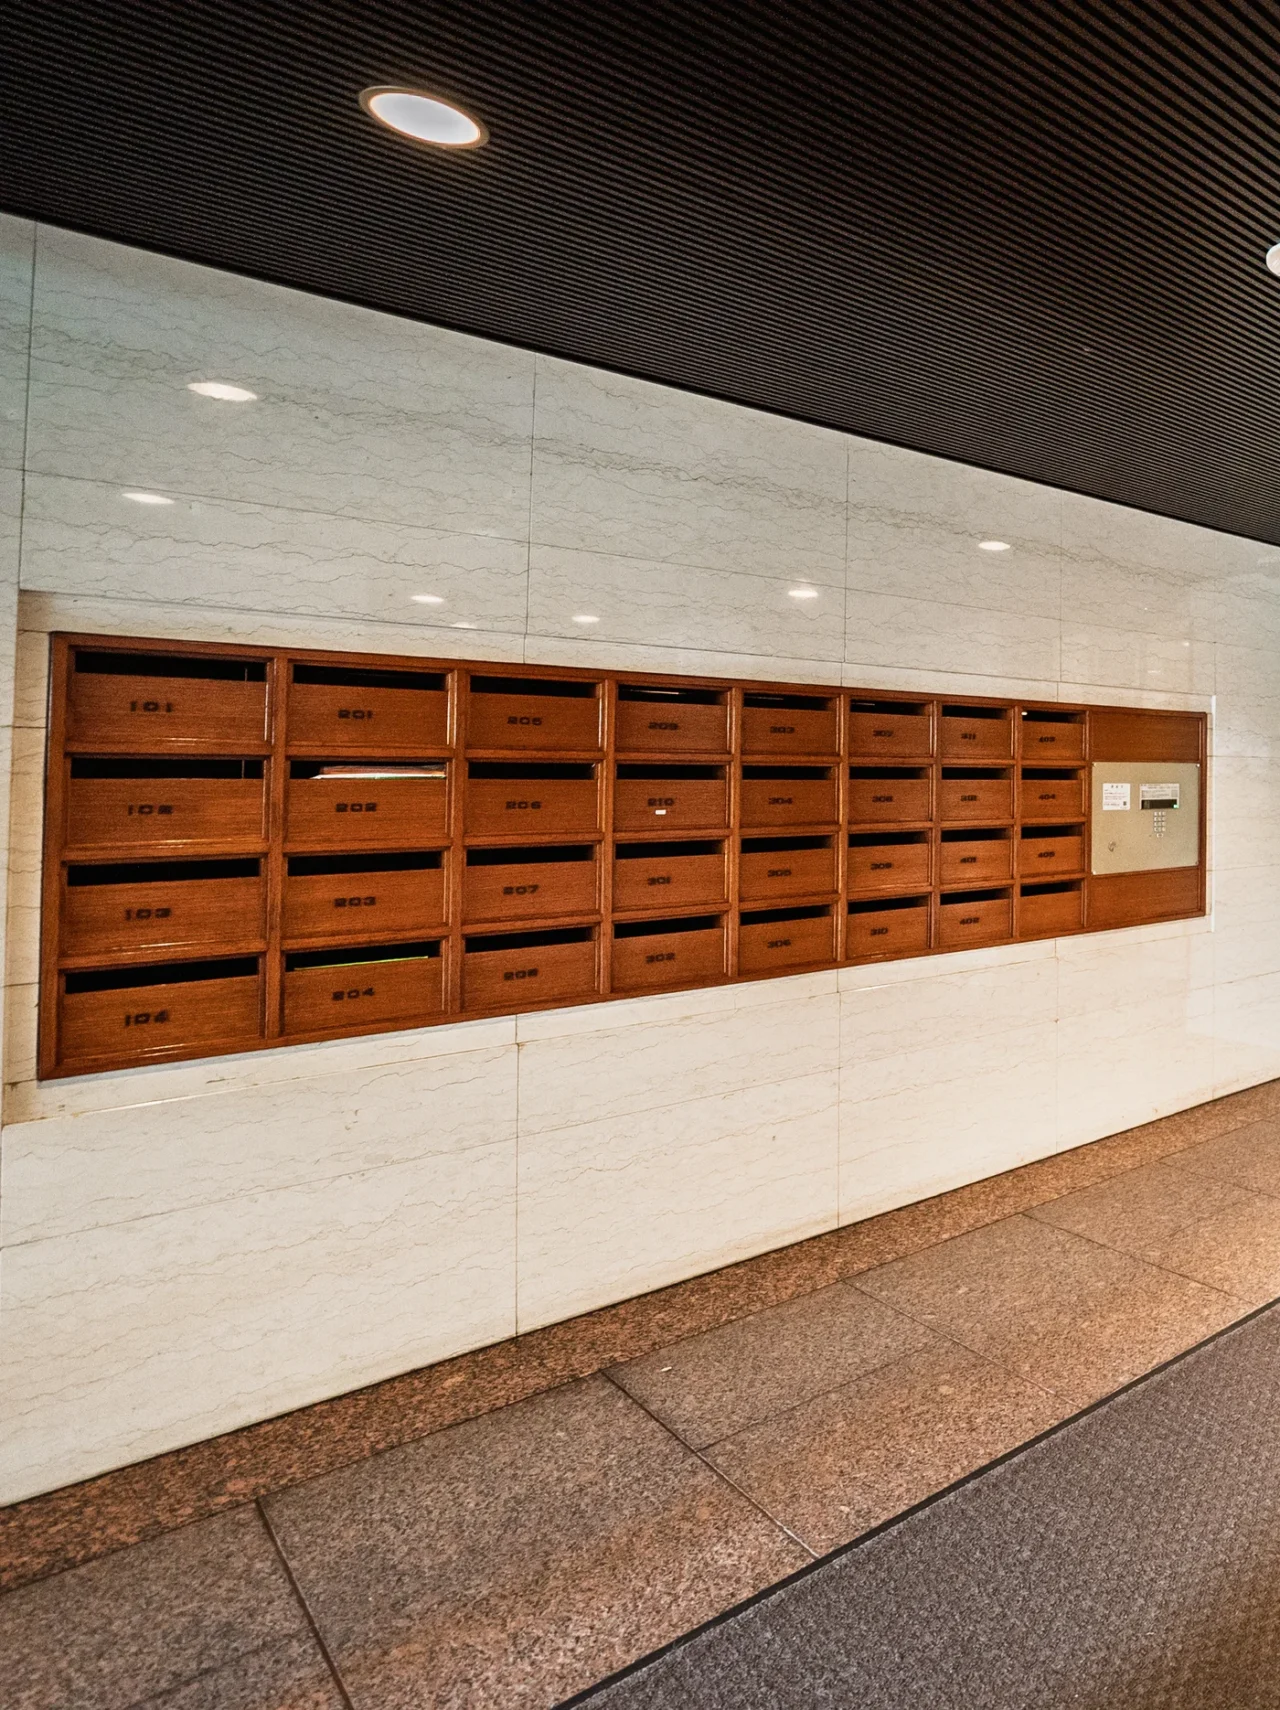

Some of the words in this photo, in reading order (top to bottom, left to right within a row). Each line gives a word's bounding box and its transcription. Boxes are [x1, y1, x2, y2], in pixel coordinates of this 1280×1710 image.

[129, 700, 173, 713] 101
[337, 709, 374, 720] 201
[335, 802, 378, 813] 202
[505, 800, 542, 810] 206
[647, 797, 675, 807] 210
[127, 804, 174, 816] 102
[646, 875, 672, 887] 301
[502, 884, 540, 896] 207
[333, 896, 377, 909] 203
[124, 907, 172, 922] 103
[645, 952, 676, 965] 302
[331, 987, 375, 1002] 204
[124, 1010, 170, 1028] 104
